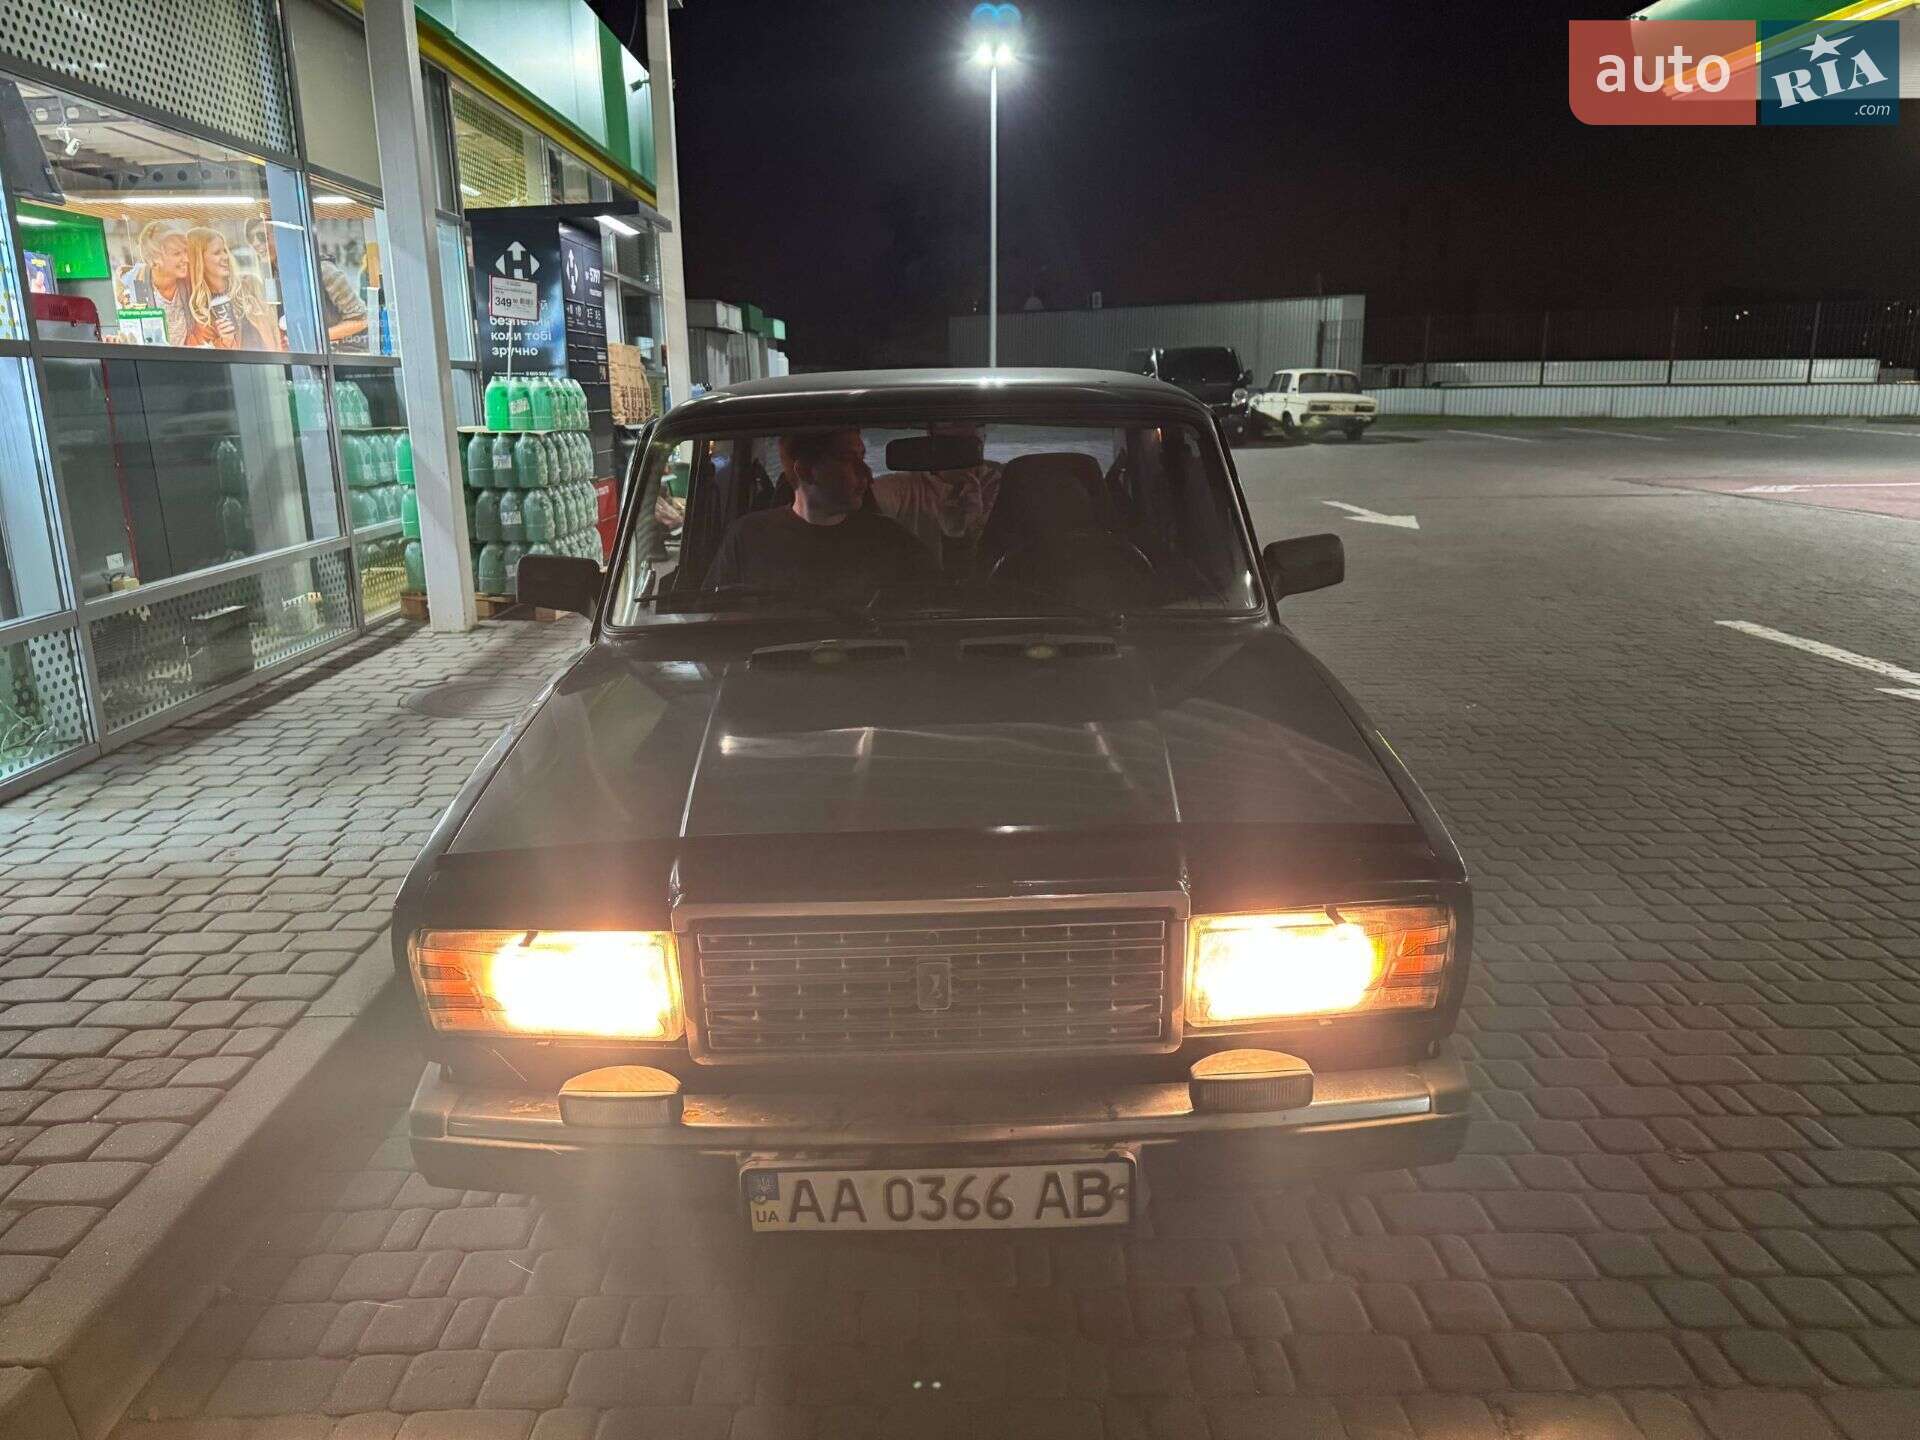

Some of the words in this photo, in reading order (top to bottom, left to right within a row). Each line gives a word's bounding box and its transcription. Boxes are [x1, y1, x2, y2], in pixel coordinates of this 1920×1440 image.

[495, 296, 512, 307] 349
[491, 331, 522, 341] коли
[524, 330, 552, 341] тобі
[491, 347, 538, 358] зручно
[789, 1178, 867, 1223] AA
[884, 1174, 1015, 1222] 0366
[1034, 1169, 1114, 1220] AB
[756, 1210, 780, 1223] UA
